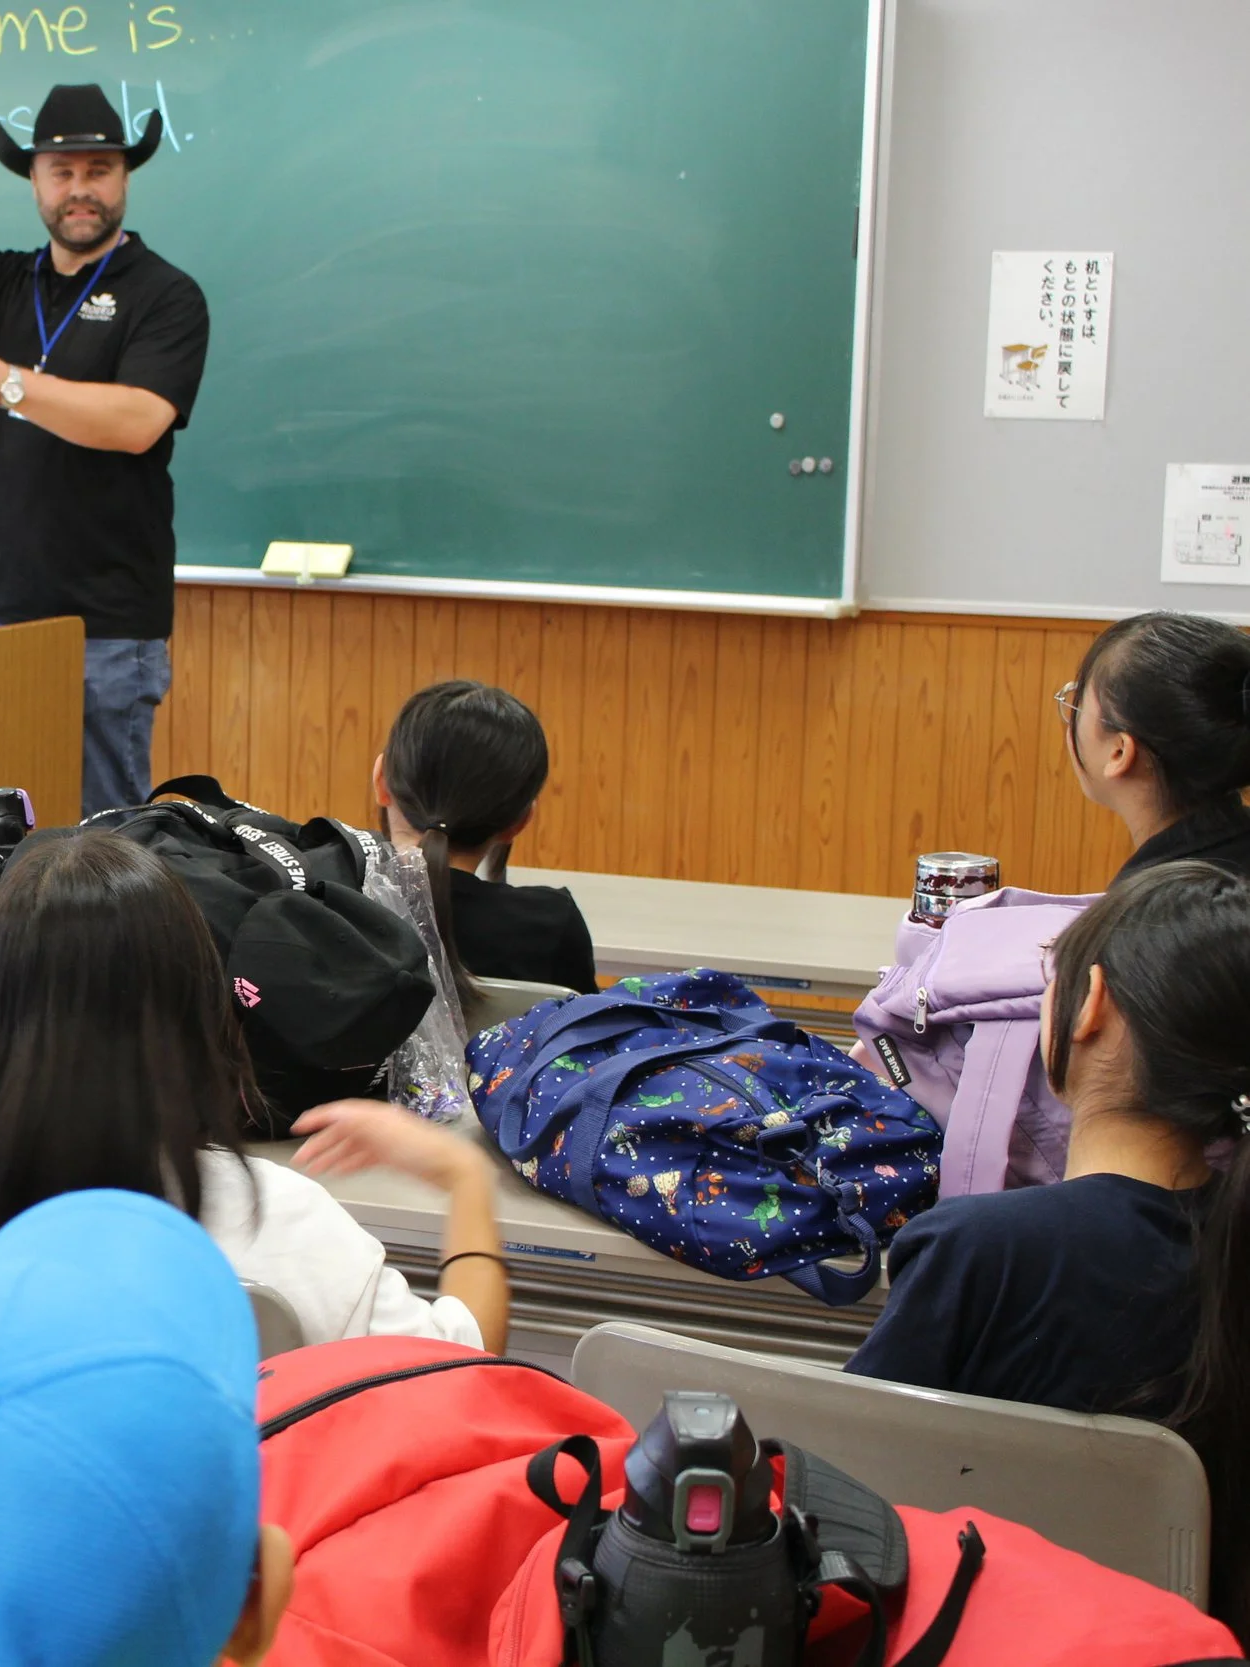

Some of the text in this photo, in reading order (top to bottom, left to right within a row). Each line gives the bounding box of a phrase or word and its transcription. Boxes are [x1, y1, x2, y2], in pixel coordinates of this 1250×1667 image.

[121, 79, 194, 153] ld.
[1039, 259, 1055, 329] ください。
[1081, 259, 1100, 345] 机といすは、
[1056, 259, 1077, 409] もとの状態に戻して
[258, 841, 300, 867] STREET
[878, 1038, 892, 1057] BAG
